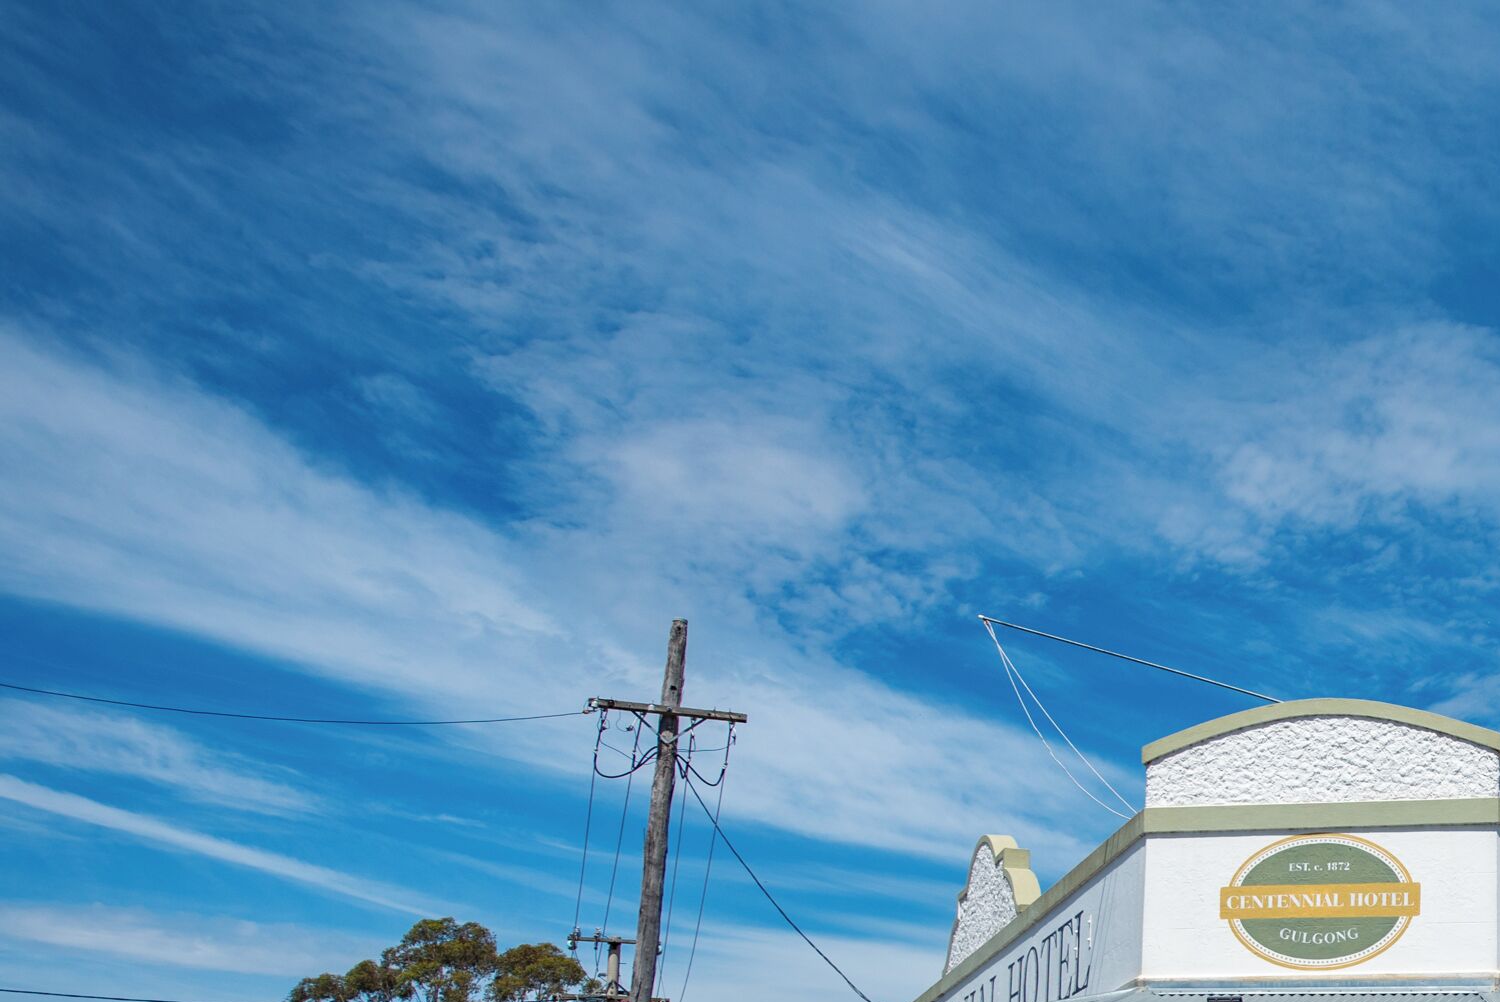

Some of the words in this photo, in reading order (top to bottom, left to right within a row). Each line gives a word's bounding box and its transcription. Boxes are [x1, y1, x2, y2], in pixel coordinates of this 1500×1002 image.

[1288, 863, 1311, 872] EST.
[1326, 862, 1350, 871] 1872
[1226, 893, 1344, 910] CENTENNIAL
[1350, 892, 1414, 907] HOTEL
[1279, 928, 1359, 945] GULGONG
